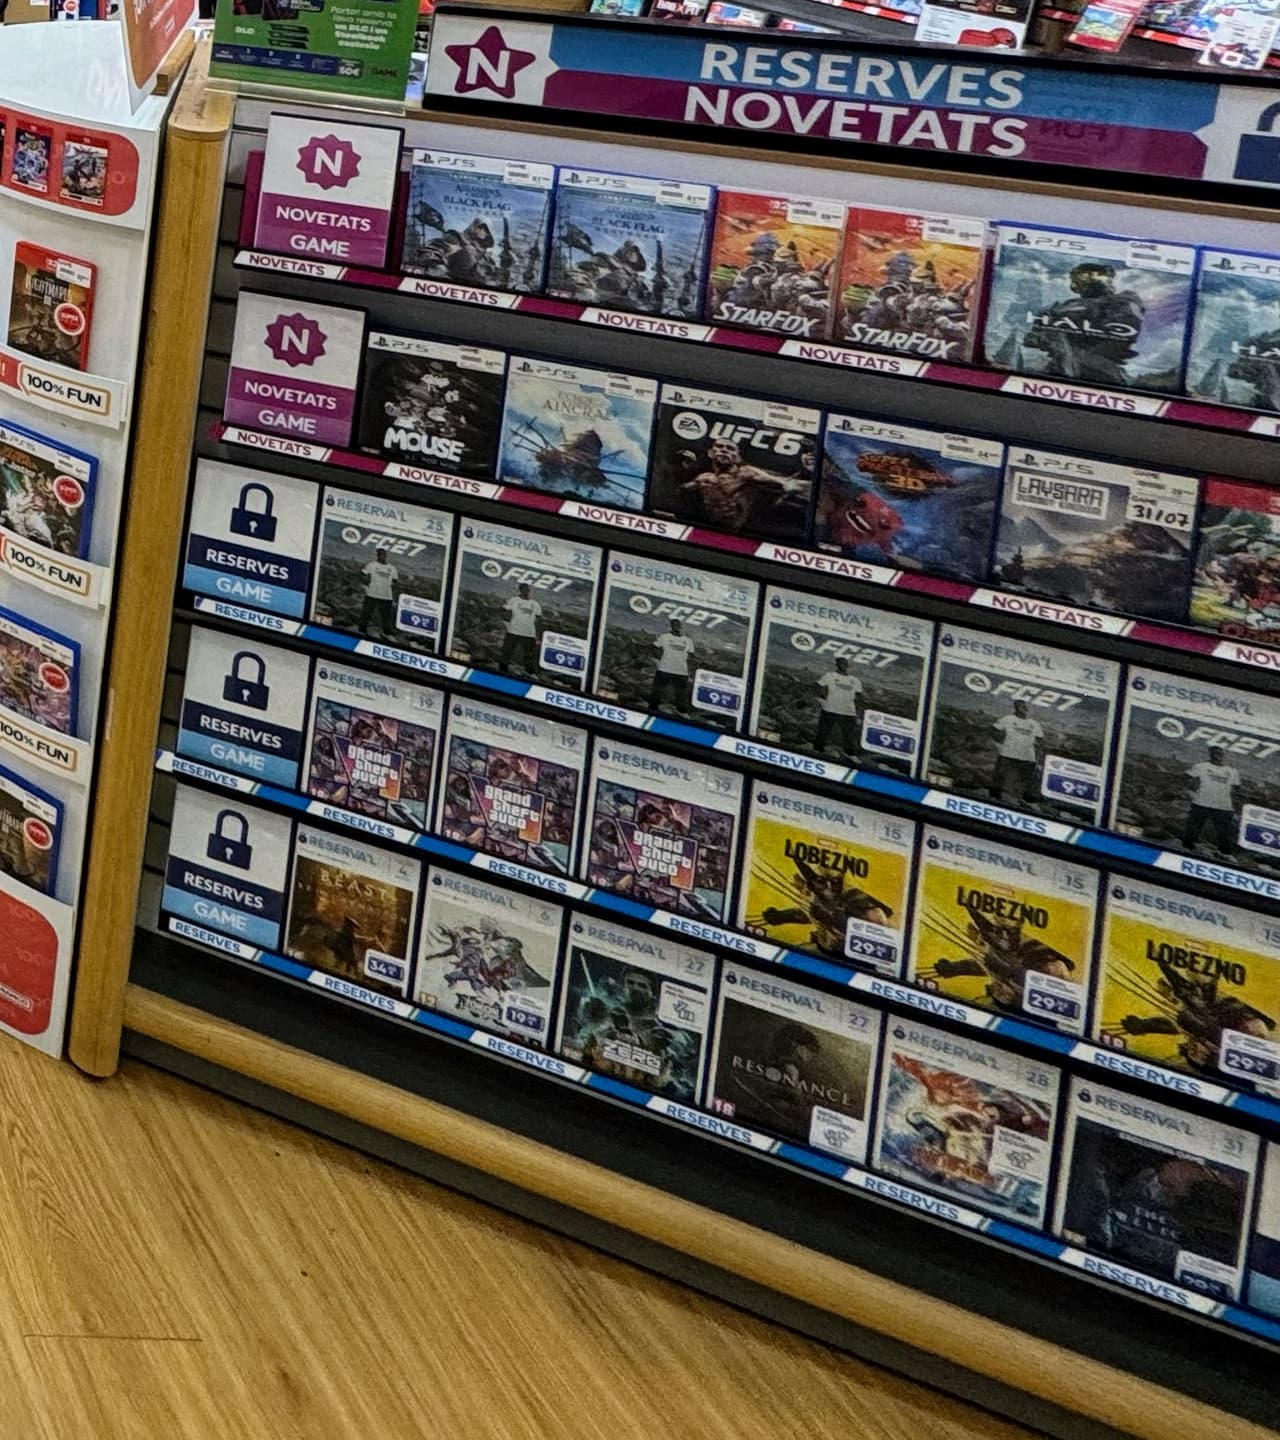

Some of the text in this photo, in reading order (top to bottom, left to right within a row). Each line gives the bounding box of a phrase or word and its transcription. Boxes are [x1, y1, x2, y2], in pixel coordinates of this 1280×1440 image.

[467, 47, 511, 90] N
[700, 44, 1026, 109] RESERVES
[683, 85, 1028, 158] NOVETATS
[276, 206, 372, 233] NOVETATS
[290, 235, 350, 258] GAME
[248, 254, 325, 276] NOVETATS
[414, 281, 499, 305] NOVETATS
[1026, 310, 1138, 337] HALO
[798, 344, 901, 373] NOVETATS
[27, 373, 102, 408] 100% FUN
[258, 409, 316, 434] GAME
[383, 427, 465, 462] MOUSE
[708, 420, 803, 455] UFC 6
[1017, 475, 1105, 509] LAYSARA
[337, 498, 408, 522] RESERVA'L
[361, 532, 427, 557] FC27
[476, 529, 552, 556] RESERVA'L
[205, 548, 290, 580] RESERVES
[215, 576, 273, 604] GAME
[214, 603, 284, 629] RESERVES
[372, 646, 448, 674] RESERVES
[347, 744, 392, 764] grand
[355, 759, 398, 780] theft
[882, 825, 902, 840] 15
[784, 838, 870, 878] LOBEZNO
[956, 886, 1050, 930] LOBEZNO
